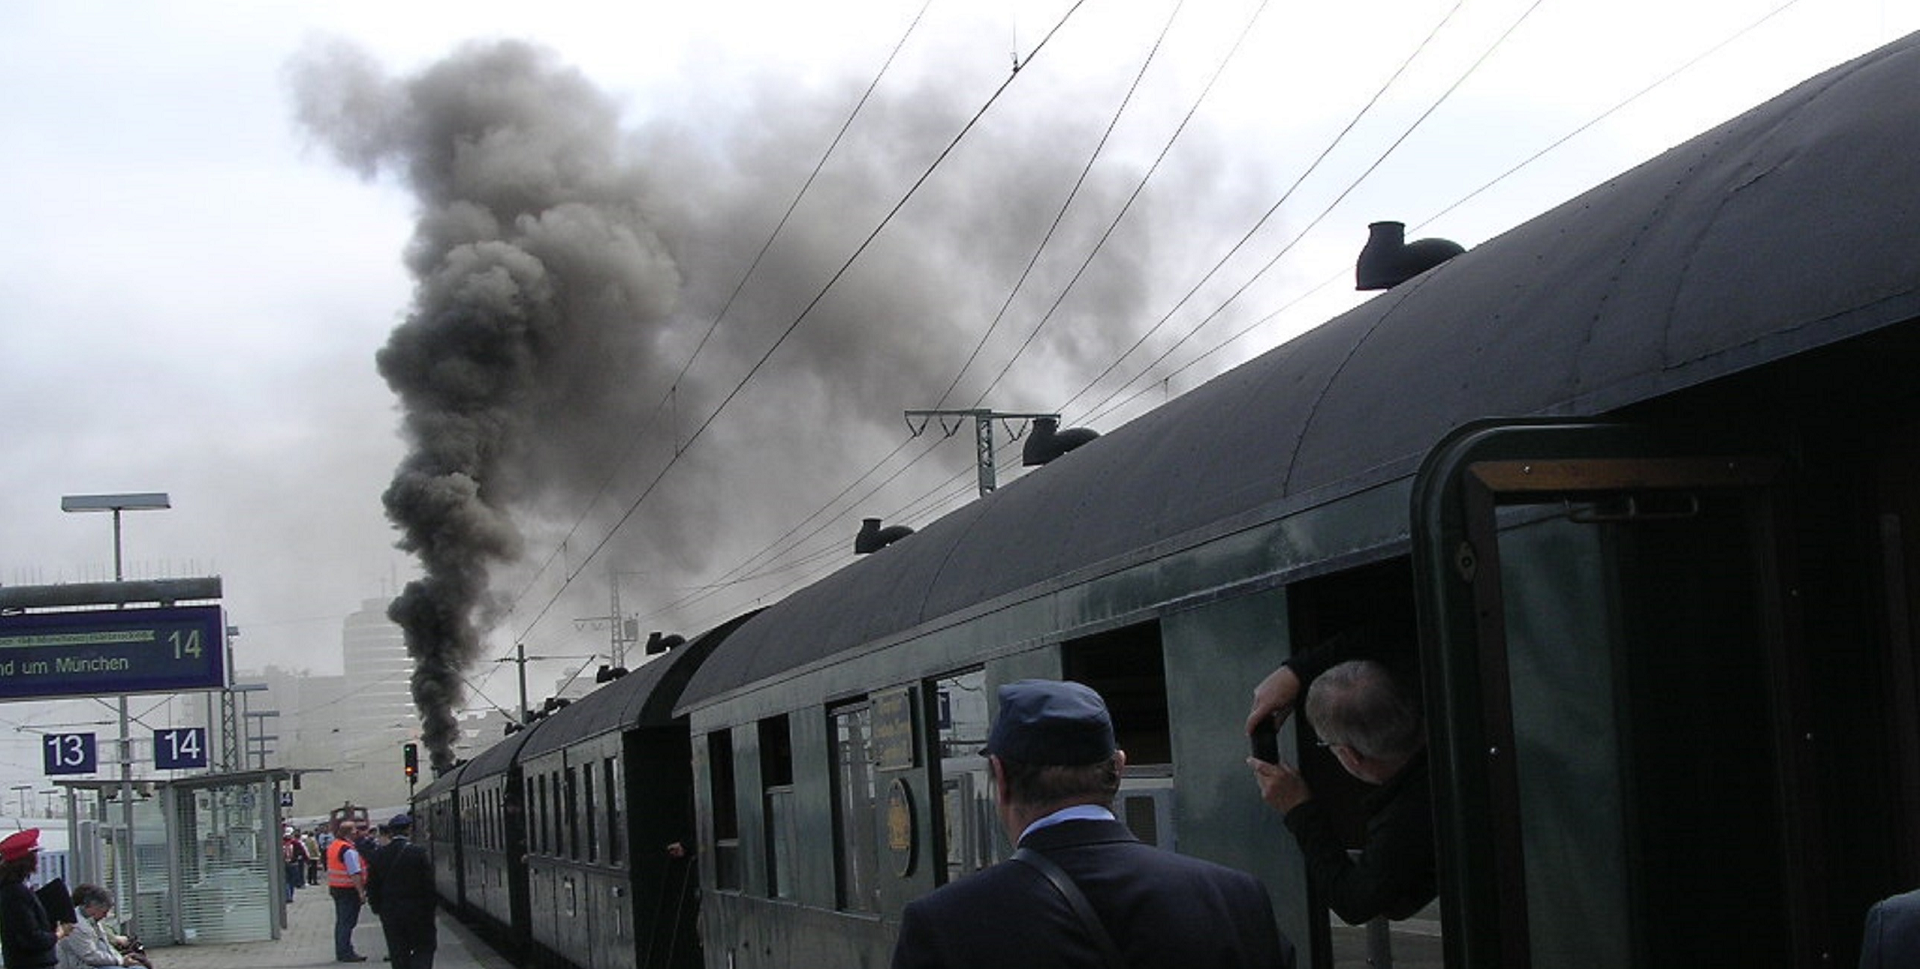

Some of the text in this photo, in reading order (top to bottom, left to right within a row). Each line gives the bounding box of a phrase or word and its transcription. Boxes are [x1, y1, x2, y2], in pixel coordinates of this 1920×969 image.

[168, 629, 202, 659] 14
[22, 661, 47, 674] um
[56, 656, 129, 673] München
[48, 735, 85, 766] 13
[164, 729, 201, 760] 14
